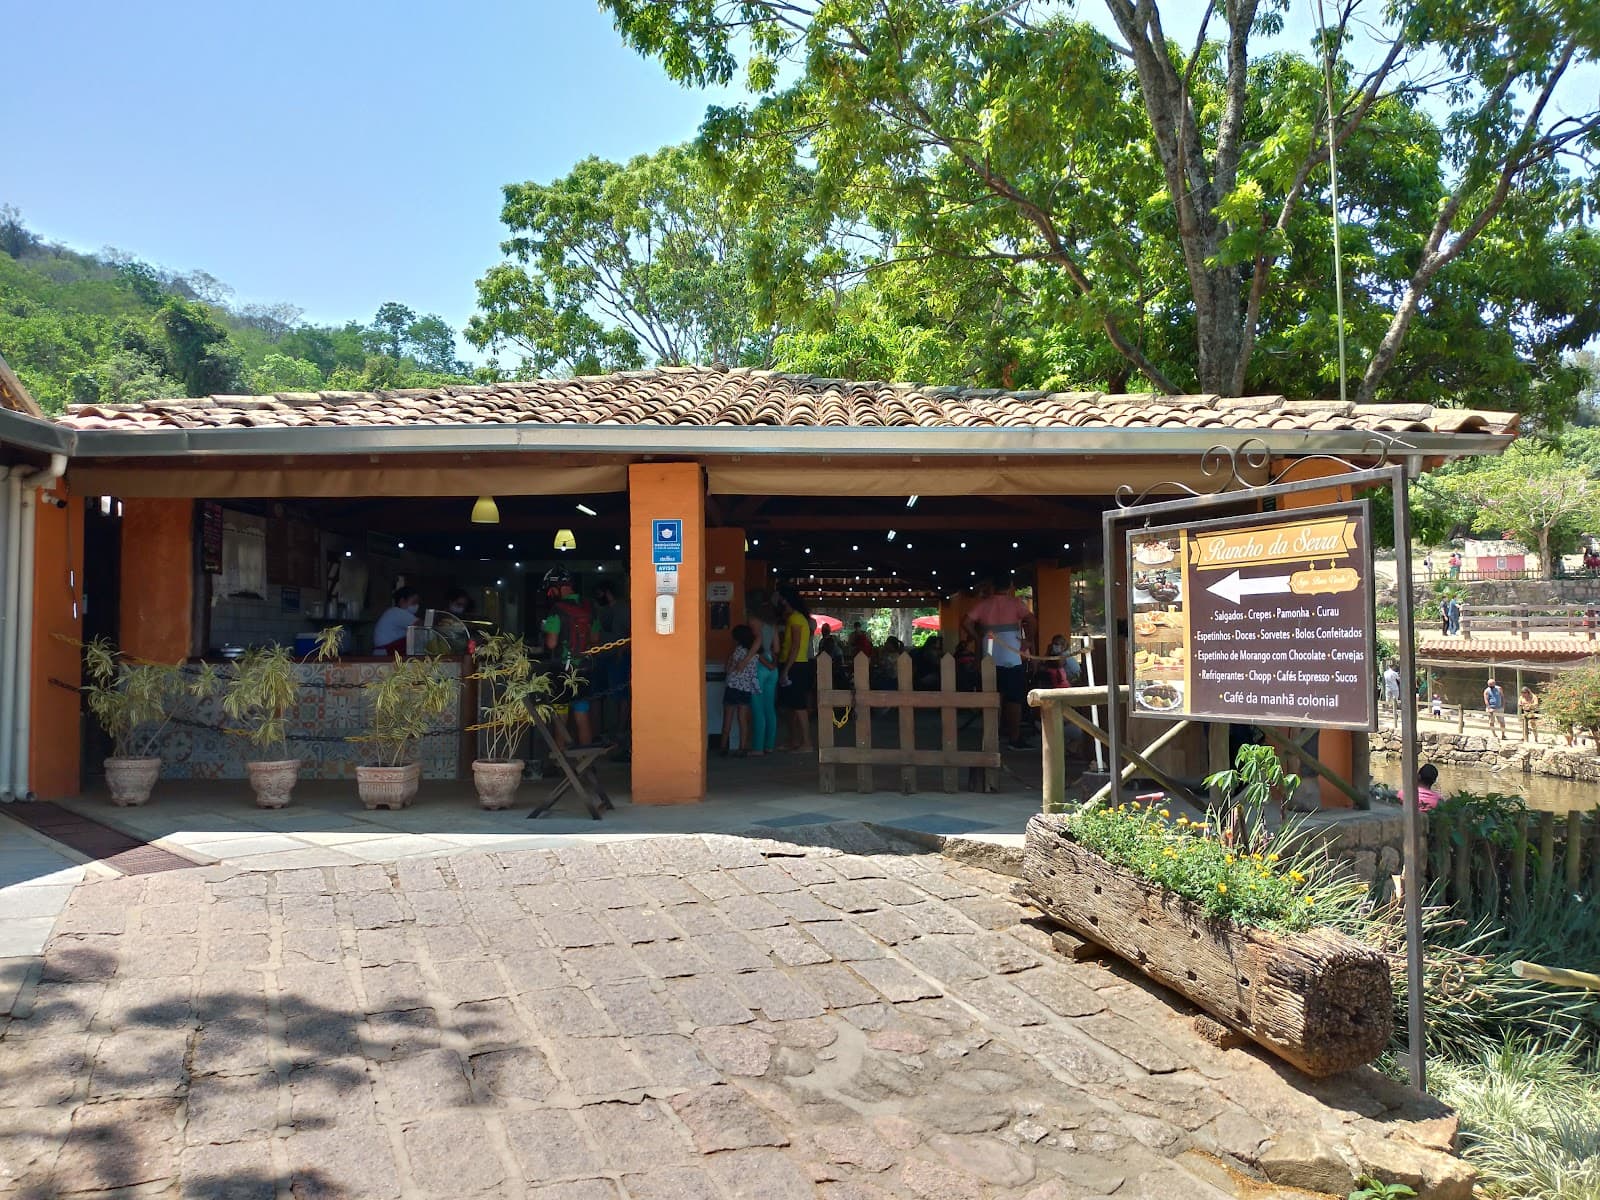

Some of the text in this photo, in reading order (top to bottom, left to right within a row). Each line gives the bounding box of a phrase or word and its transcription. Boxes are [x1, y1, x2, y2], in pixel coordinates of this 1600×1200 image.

[1204, 528, 1339, 561] Rancho da Serra
[1214, 606, 1339, 623] Salgados Crepes Pamonha Curau
[1197, 626, 1362, 644] Espetinhos Doces Sorvetes Bolos Confeitados
[1198, 648, 1364, 663] Espetinho de Morango com Chocolate Cervejas
[1201, 669, 1358, 684] Refrigerantes Chopp Cafés Expresso Sucos
[1223, 691, 1339, 707] Café da manhã colonial
